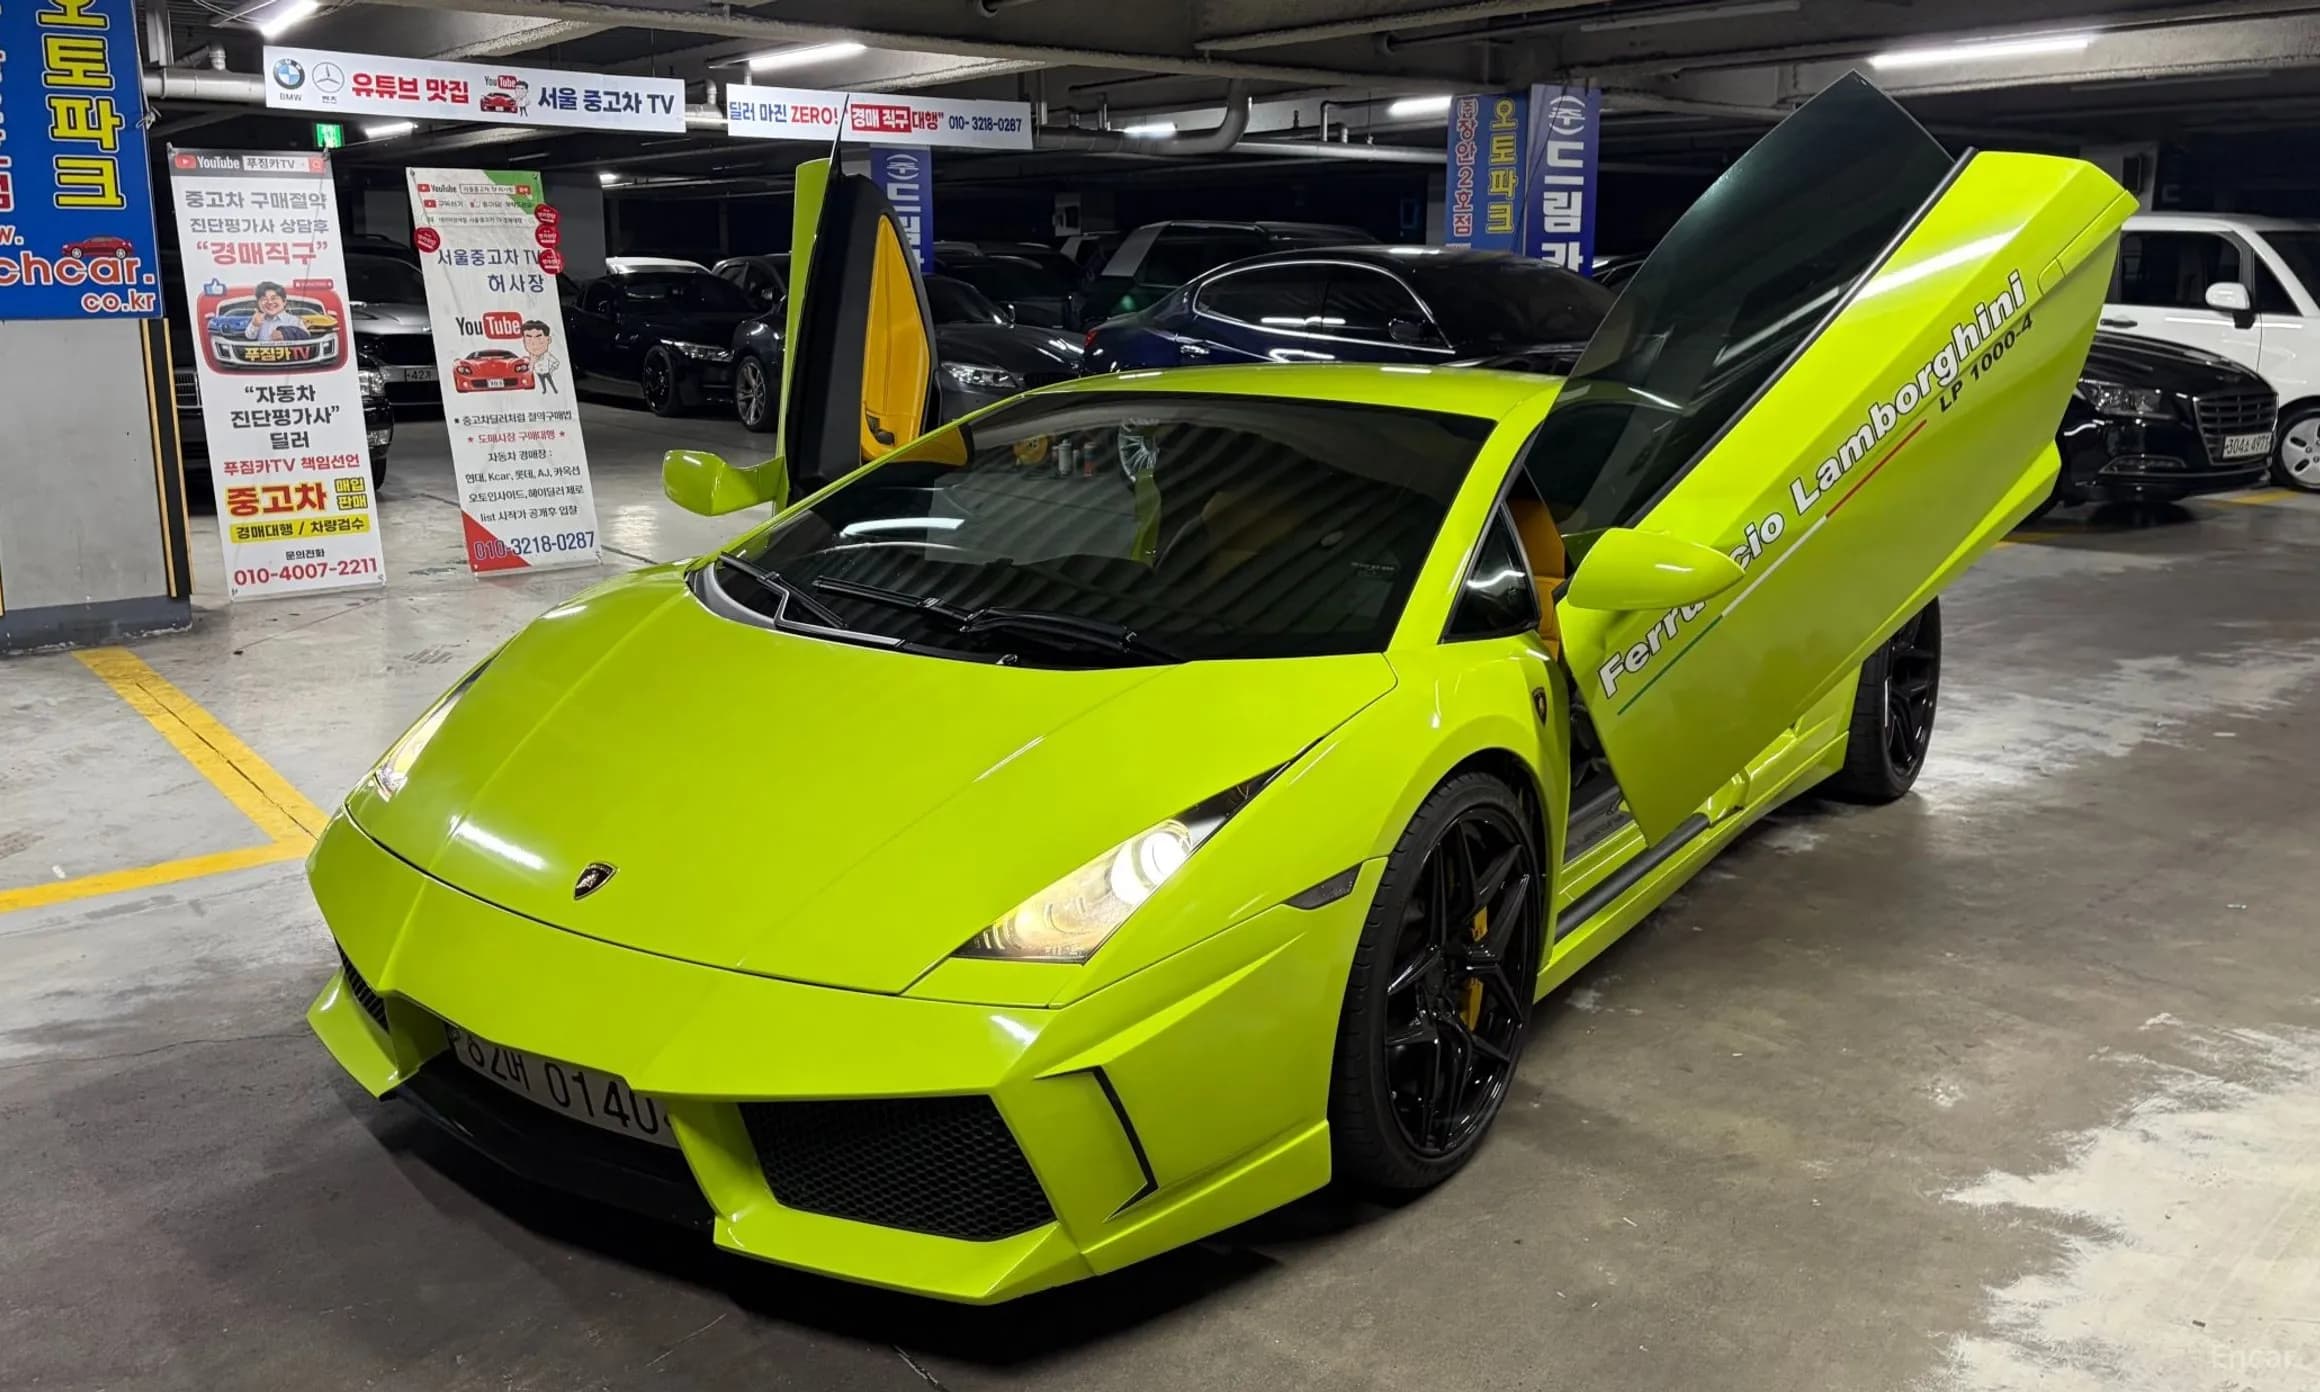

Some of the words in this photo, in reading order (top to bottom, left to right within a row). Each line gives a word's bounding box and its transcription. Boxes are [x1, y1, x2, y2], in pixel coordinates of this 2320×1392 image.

[352, 72, 420, 101] 유튜브
[425, 78, 470, 104] 맛집
[484, 75, 517, 89] YouTube
[538, 87, 578, 111] 서울
[583, 89, 642, 114] 중고차
[647, 94, 675, 115] TV
[729, 101, 755, 121] 딜러
[759, 103, 787, 123] 마진
[790, 105, 838, 125] ZERO!
[972, 116, 1023, 132] 3218-0287
[197, 155, 240, 169] YouTube
[1485, 98, 1519, 234] 오토파크
[185, 190, 245, 209] 중고차
[251, 191, 327, 210] 구매절약
[190, 217, 275, 233] 진단평가사
[280, 218, 329, 234] 상담후
[438, 248, 519, 267] 서울중고차
[487, 274, 545, 293] 허사장
[81, 291, 155, 313] co.kr
[455, 314, 522, 337] YouTube
[1938, 380, 1963, 413] LP
[1969, 312, 2034, 382] 1000-4
[1789, 268, 2028, 516] Lamborghini
[270, 431, 310, 450] 딜러
[224, 458, 296, 476] 푸짐카TV
[300, 453, 360, 471] 책임선언
[488, 450, 516, 463] 자동차
[519, 449, 547, 461] 경매장
[334, 476, 366, 494] 매입
[226, 481, 328, 517] 중고차
[336, 493, 369, 511] 판매
[528, 506, 557, 520] 공개후
[235, 523, 294, 540] 경매대행
[310, 517, 364, 534] 차량검수
[285, 548, 325, 561] 문의전화
[473, 530, 595, 561] 010-3218-0287
[233, 557, 378, 586] 010-4007-2211
